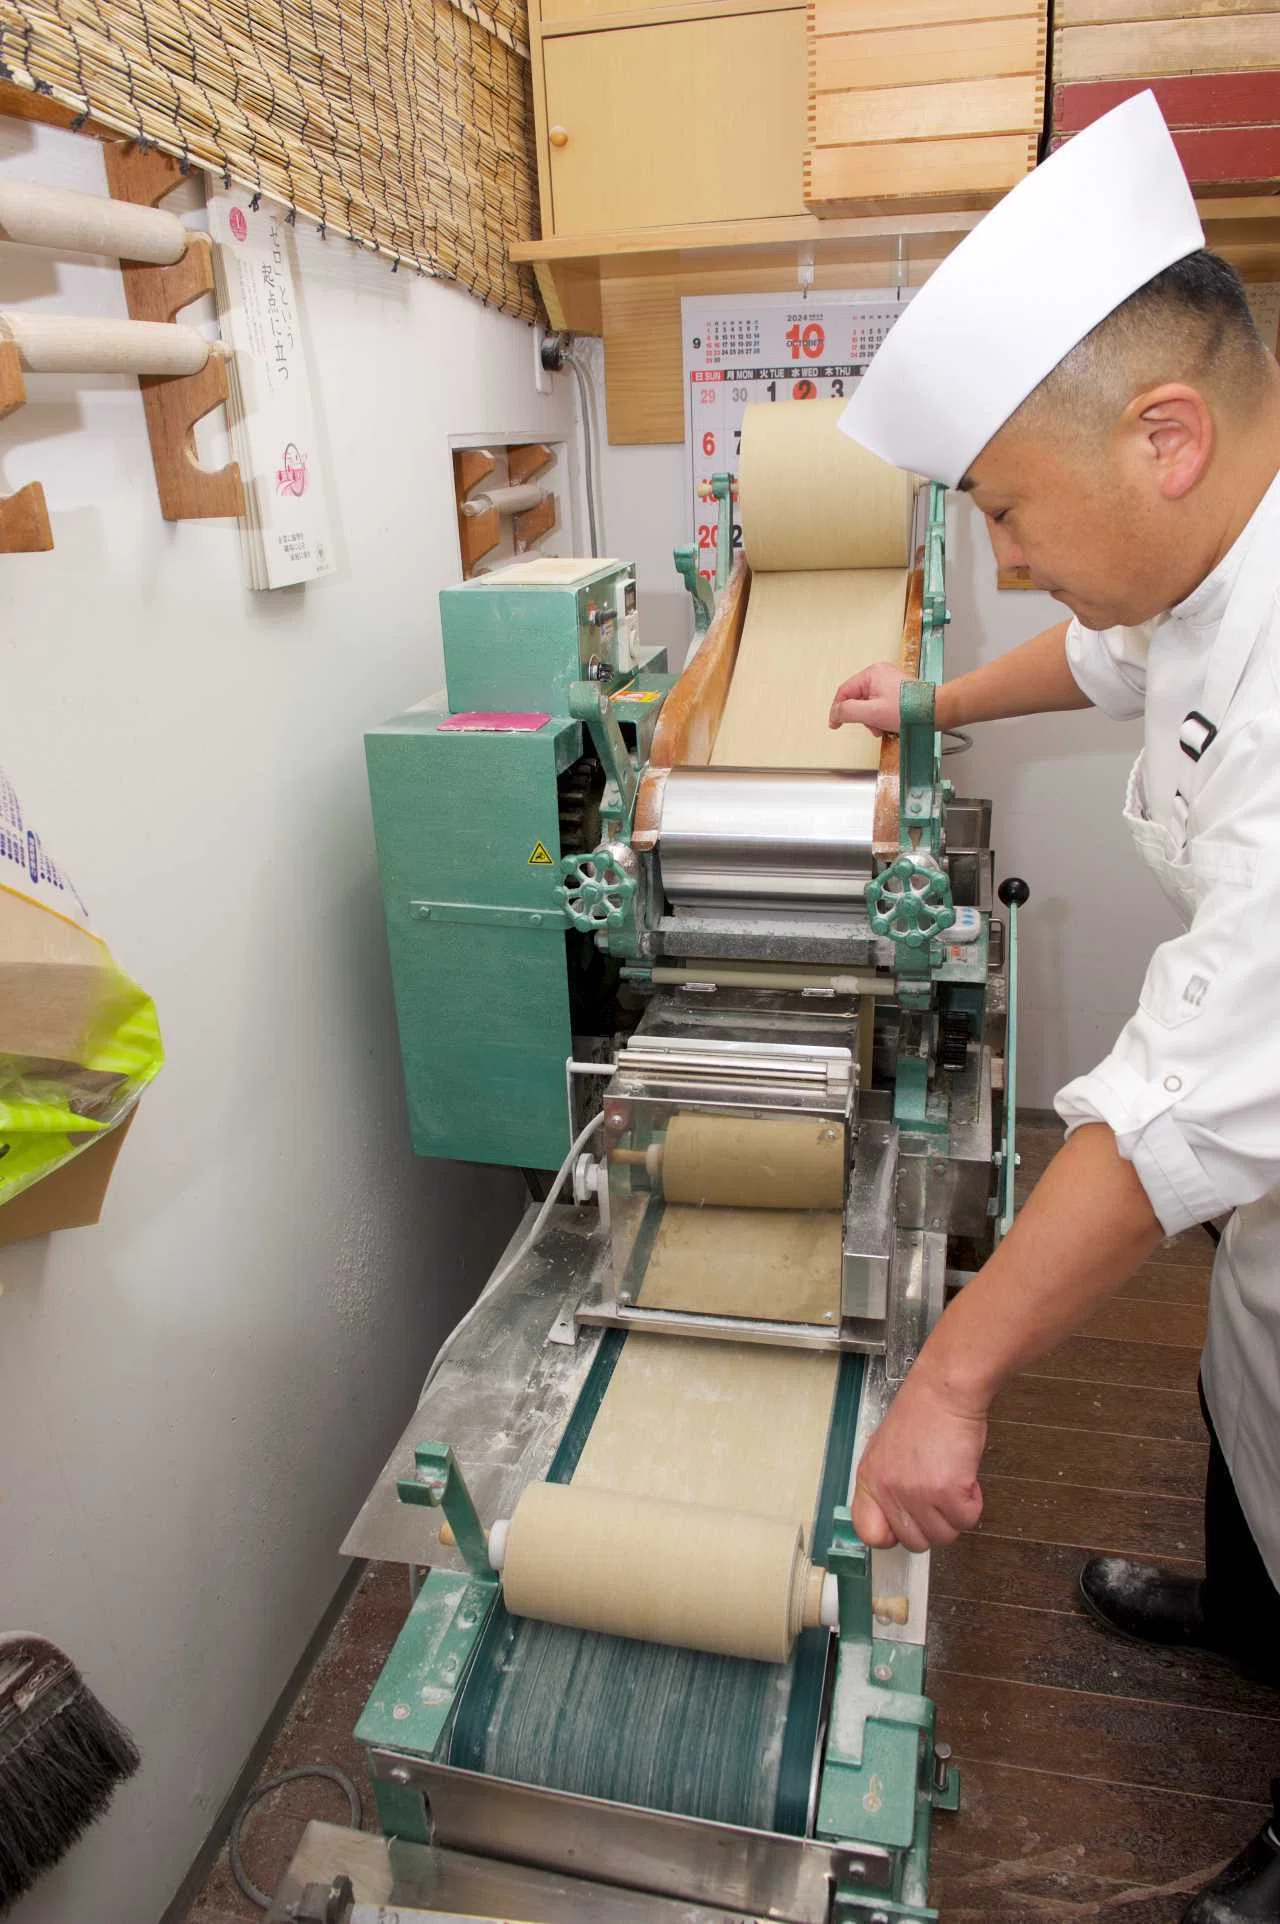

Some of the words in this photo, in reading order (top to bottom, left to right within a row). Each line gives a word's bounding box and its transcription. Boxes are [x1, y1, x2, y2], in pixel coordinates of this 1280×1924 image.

[692, 338, 701, 349] 9
[786, 323, 825, 359] 10
[696, 372, 702, 380] 日
[705, 371, 720, 380] SUN
[727, 371, 734, 380] 月
[737, 371, 753, 379] MON
[760, 370, 768, 378] 火
[770, 369, 784, 378] TUE
[792, 369, 800, 377] 水
[802, 368, 818, 377] WED
[825, 368, 833, 376] 木
[836, 367, 850, 375] THU
[701, 389, 715, 404] 29
[732, 388, 747, 402] 30
[767, 381, 776, 401] 1
[799, 380, 811, 400] 2
[831, 379, 844, 397] 3
[703, 431, 715, 456] 6
